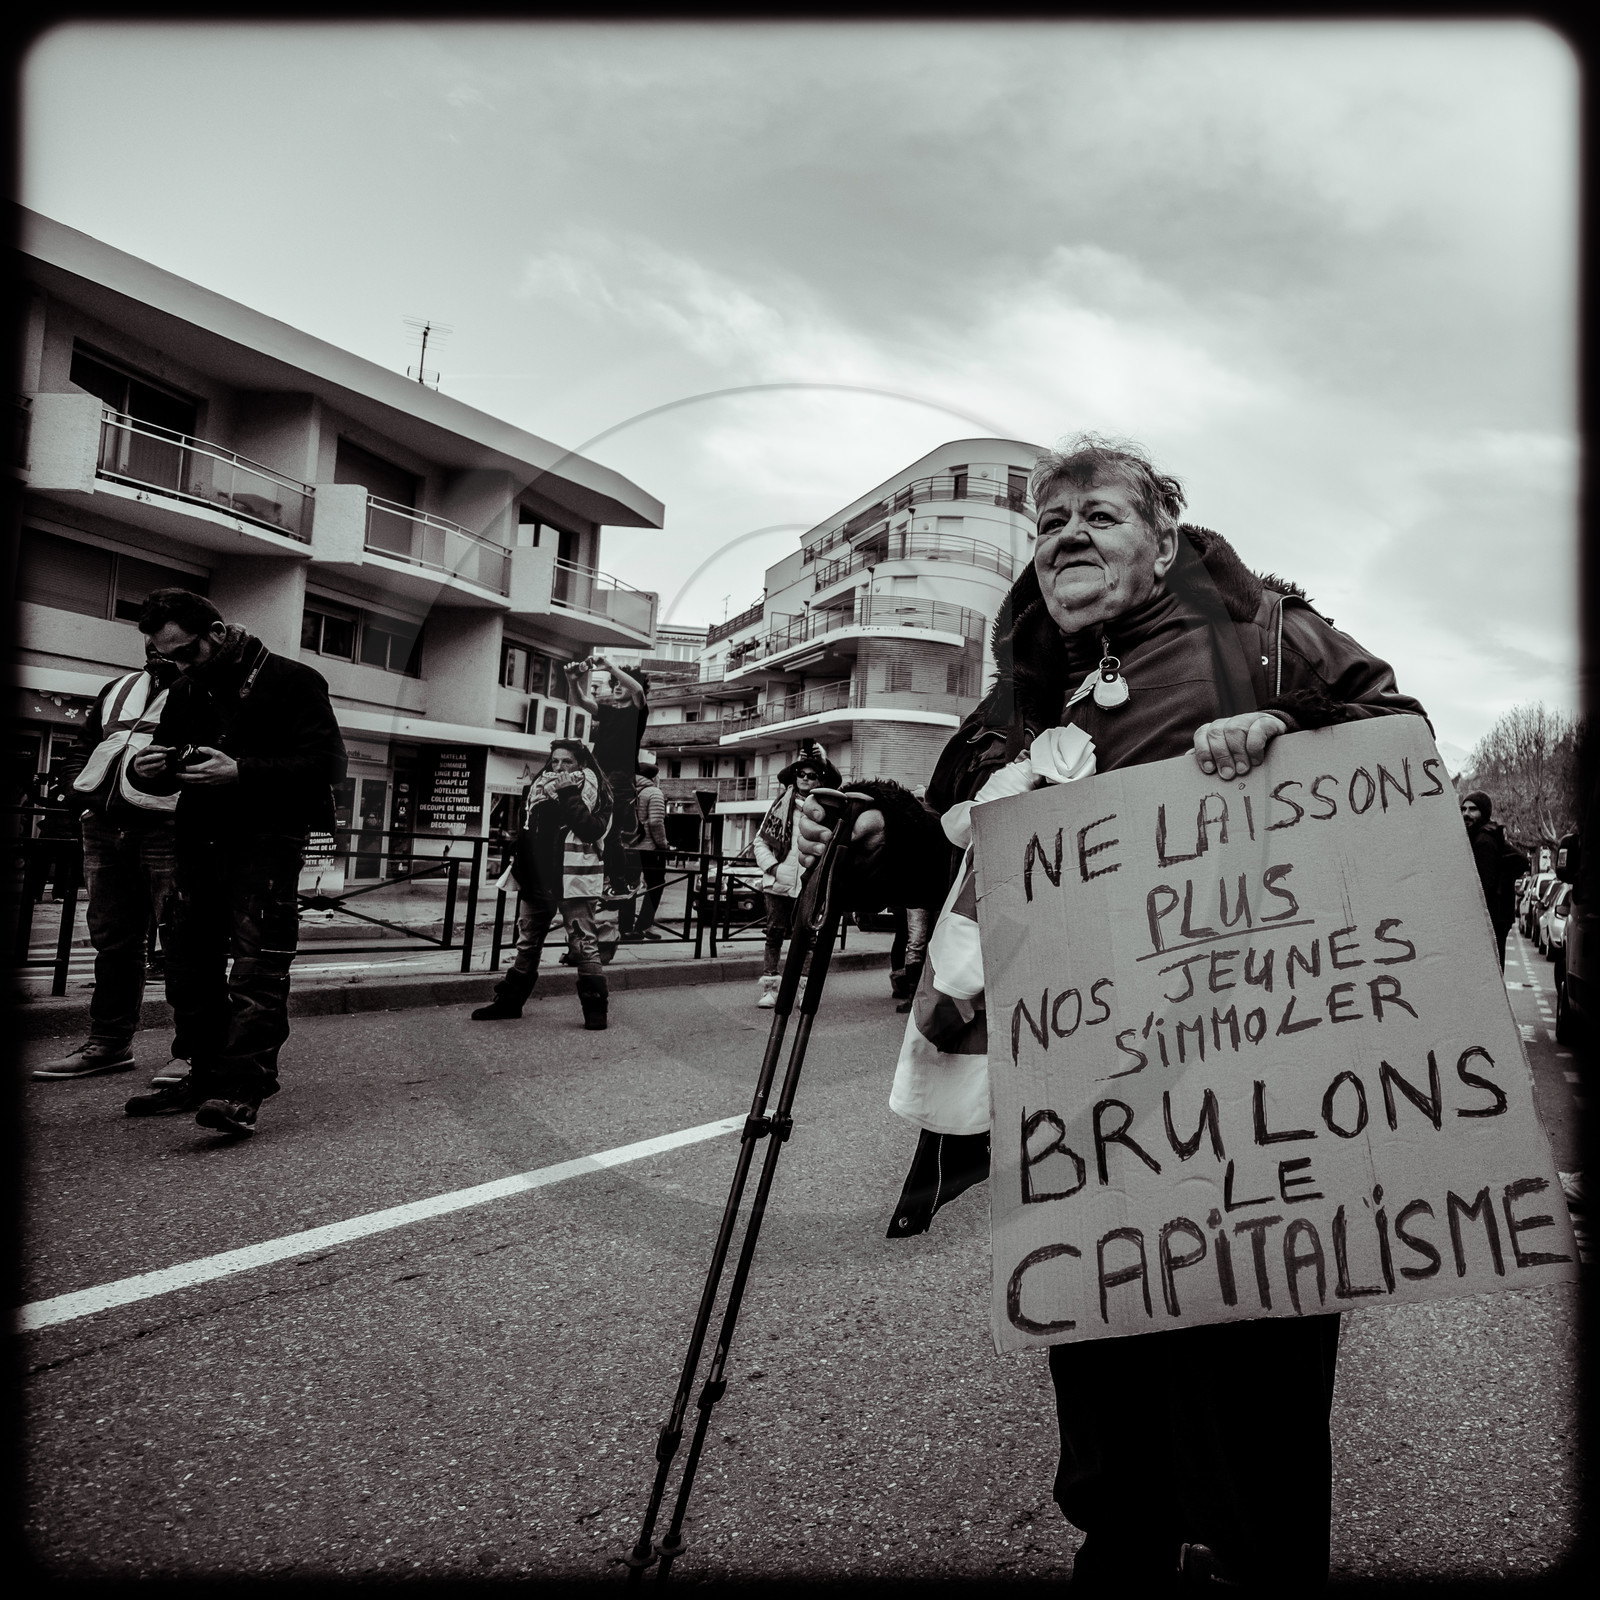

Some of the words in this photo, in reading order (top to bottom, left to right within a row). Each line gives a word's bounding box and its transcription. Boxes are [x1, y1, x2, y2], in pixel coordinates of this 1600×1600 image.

[440, 753, 466, 761] MATELAS
[433, 786, 468, 795] HÔTELLERIE
[447, 813, 455, 821] DE
[456, 805, 480, 813] MOUSSE
[1024, 814, 1123, 904] NE
[1145, 863, 1300, 955] PLUS
[1010, 977, 1116, 1068] NOS
[1158, 918, 1417, 1004] JEUNES
[1019, 1045, 1508, 1206] BRULONS
[1223, 1156, 1326, 1214] LE
